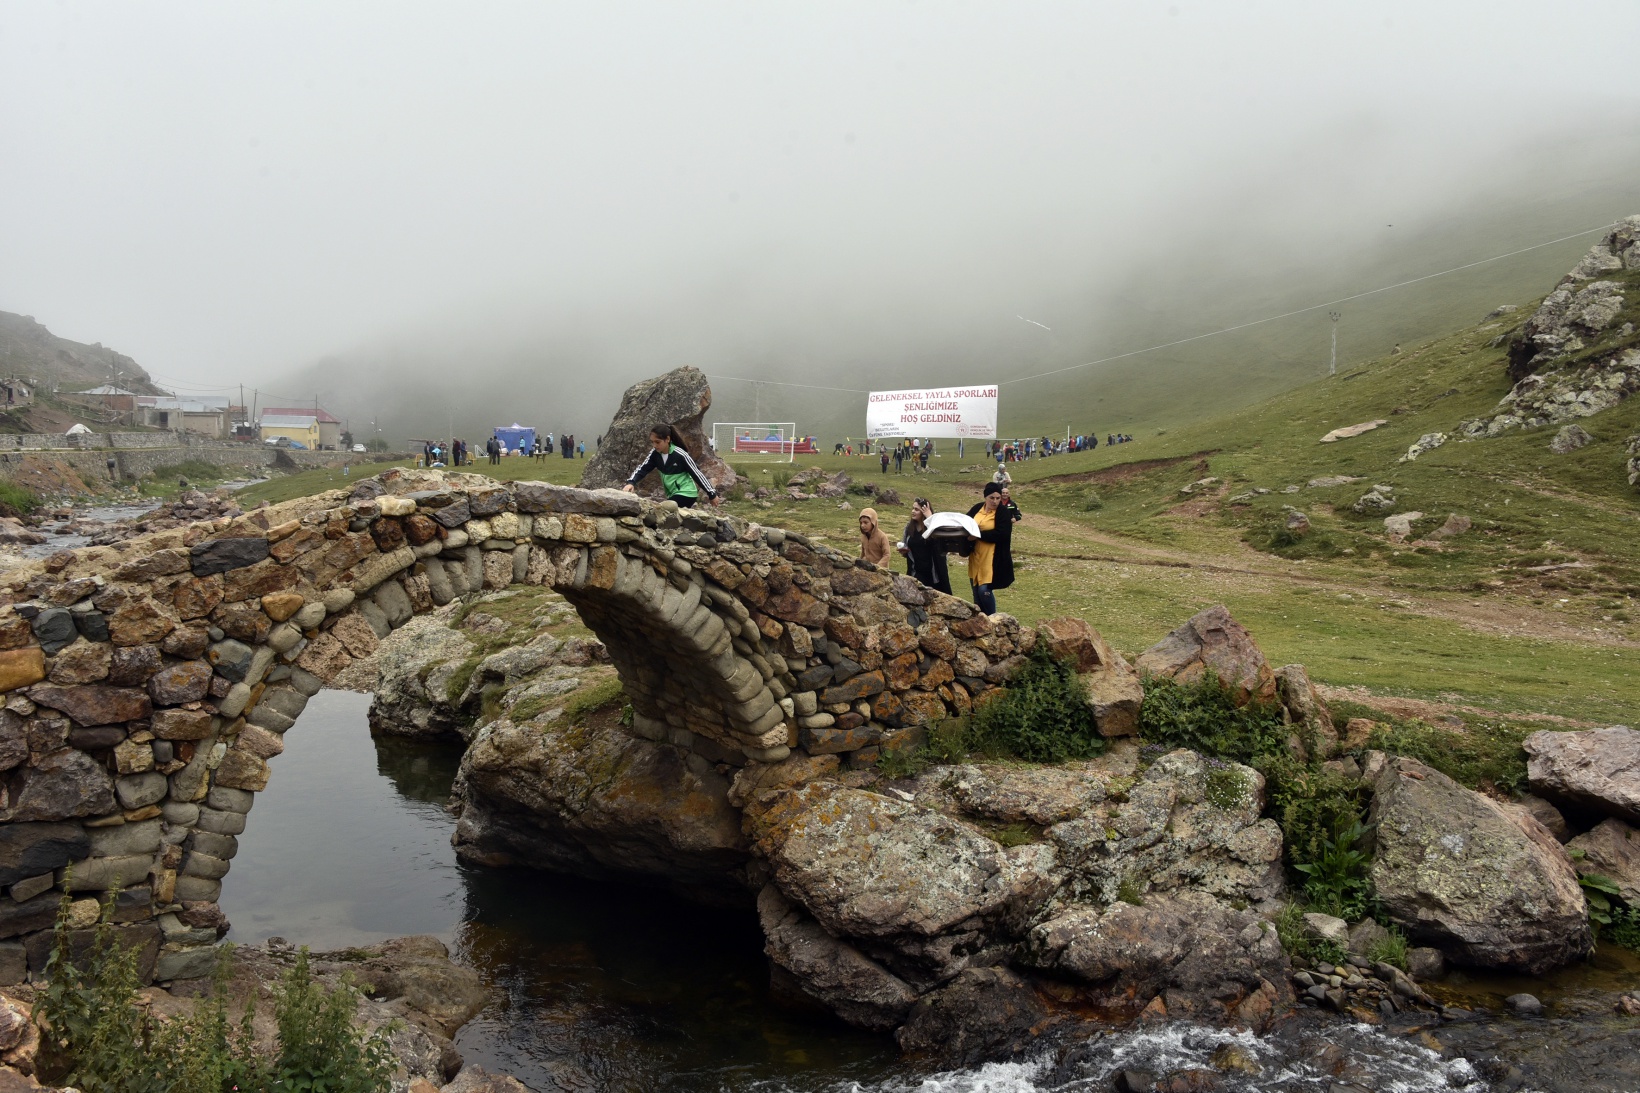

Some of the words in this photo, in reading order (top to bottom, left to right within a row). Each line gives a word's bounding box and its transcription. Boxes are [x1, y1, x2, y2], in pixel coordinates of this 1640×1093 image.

[870, 393, 922, 402] GELENEKSEL
[926, 390, 951, 399] YAYLA
[954, 389, 996, 398] SPORLARI
[904, 401, 958, 412] ŞENLİĞİMİZE
[900, 414, 918, 424] HOŞ
[920, 413, 961, 423] GELDİNİZ
